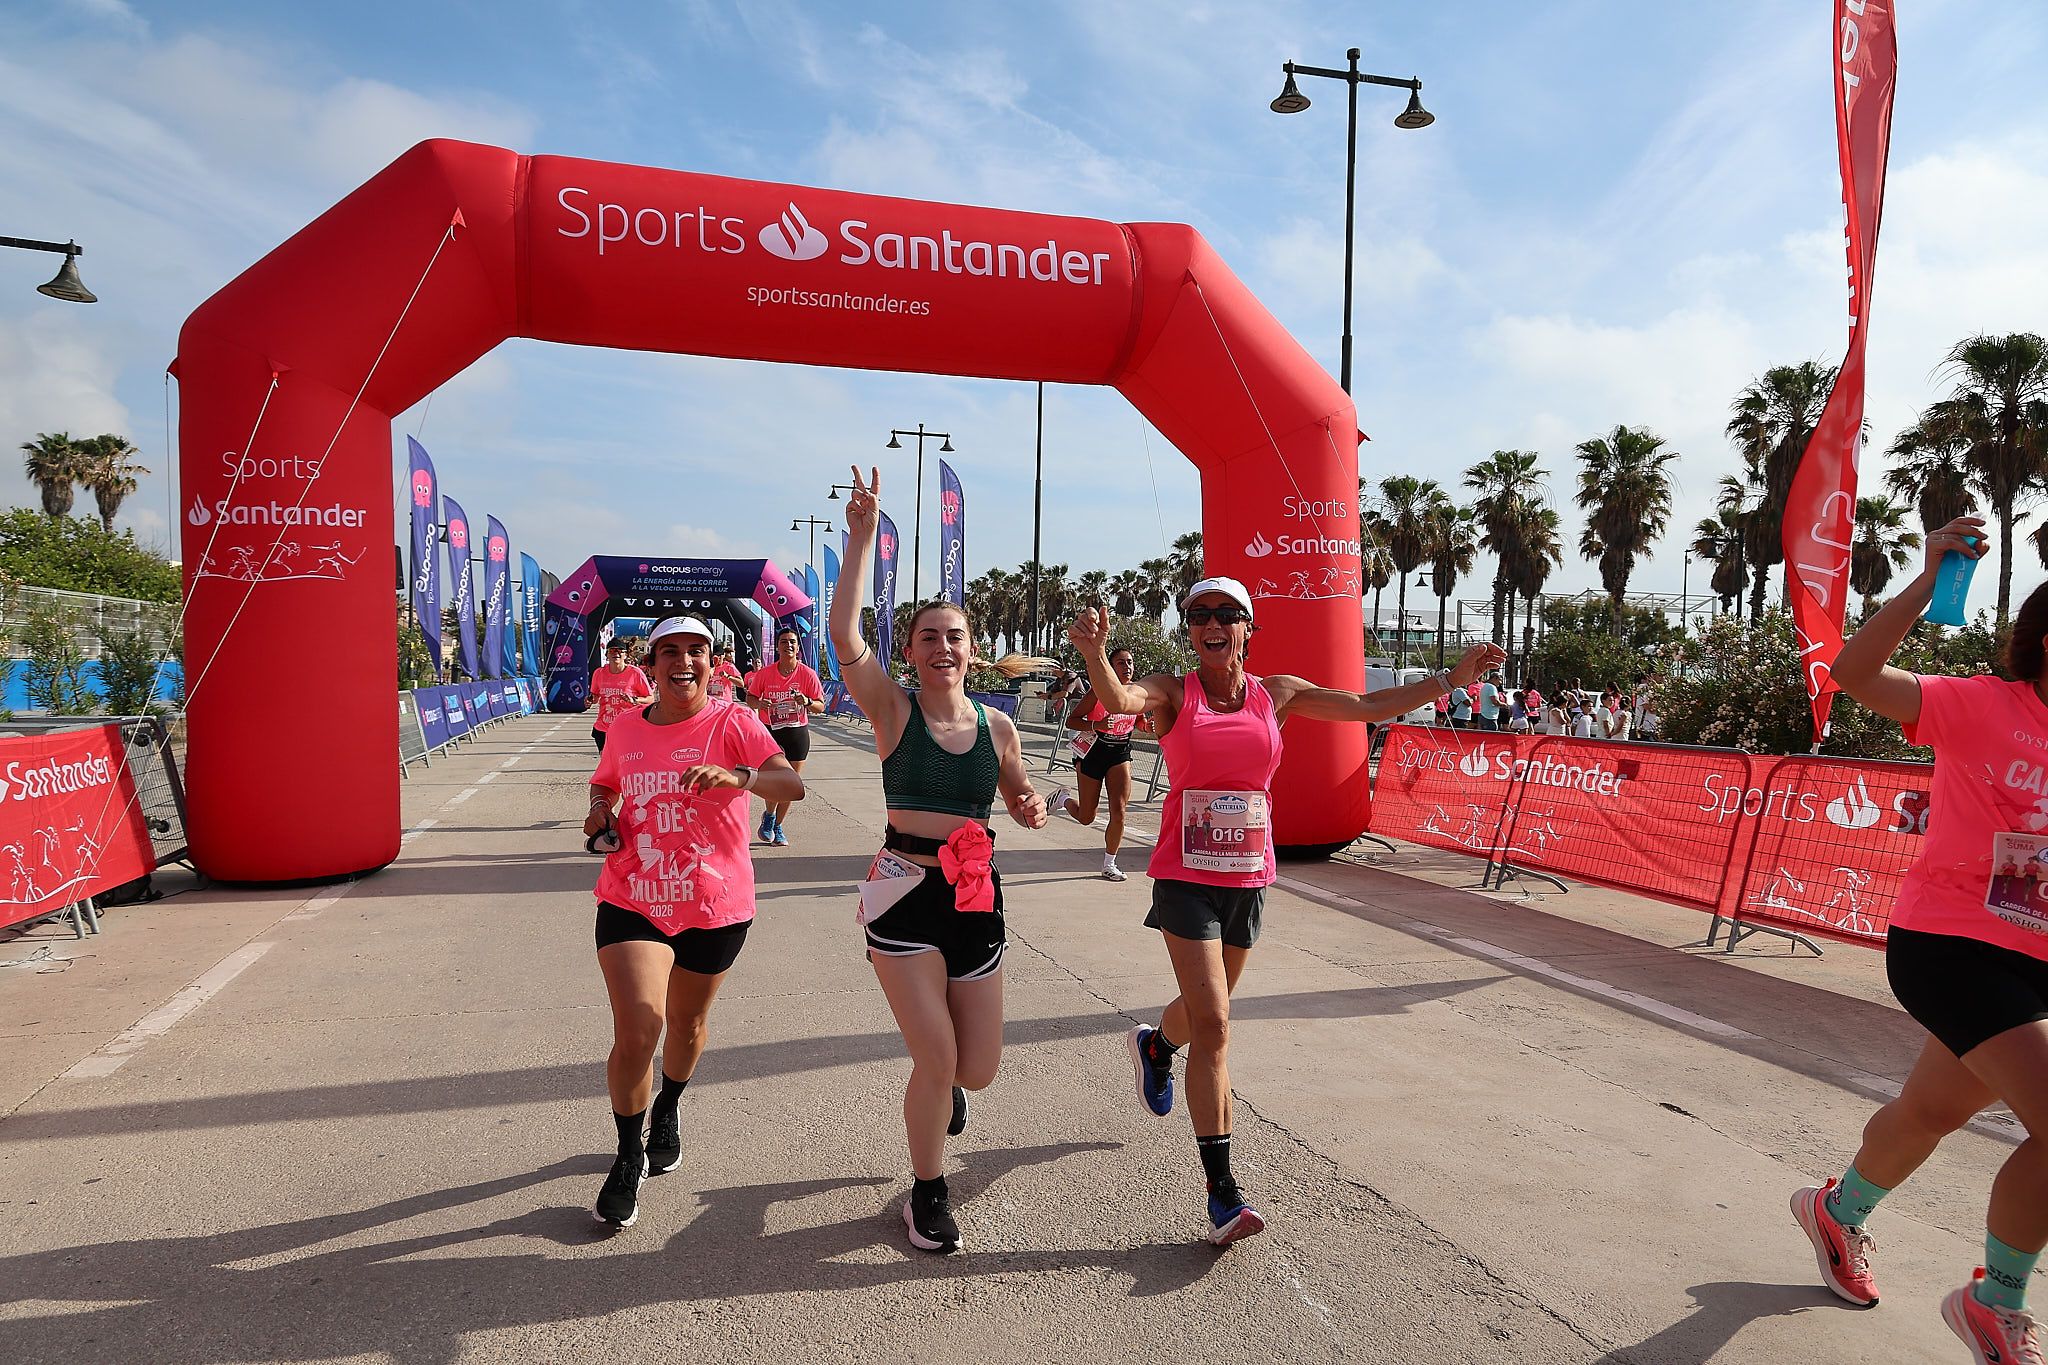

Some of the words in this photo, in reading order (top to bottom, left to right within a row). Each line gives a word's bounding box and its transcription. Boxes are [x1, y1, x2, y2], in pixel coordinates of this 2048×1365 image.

[556, 187, 746, 255] Sports
[839, 220, 1110, 286] Santander
[746, 284, 931, 316] sportssantander.es
[221, 451, 322, 483] Sports
[215, 500, 367, 528] Santander
[1283, 496, 1347, 522] Sports
[643, 577, 675, 585] ENERGÍA
[652, 565, 691, 575] octopus
[692, 567, 724, 577] energy
[623, 598, 711, 608] VOLVO
[6, 752, 112, 801] Santander
[1396, 741, 1457, 776] Sports
[1495, 751, 1627, 797] Santander
[1699, 773, 1818, 823] Sports
[656, 802, 684, 833] DE
[1212, 828, 1245, 842] 016
[2007, 843, 2035, 851] SUMA
[1192, 857, 1220, 867] OYSHO
[629, 879, 695, 903] MUJER
[650, 904, 674, 918] 2026
[2000, 900, 2030, 914] CARRERA
[2032, 909, 2042, 917] DE
